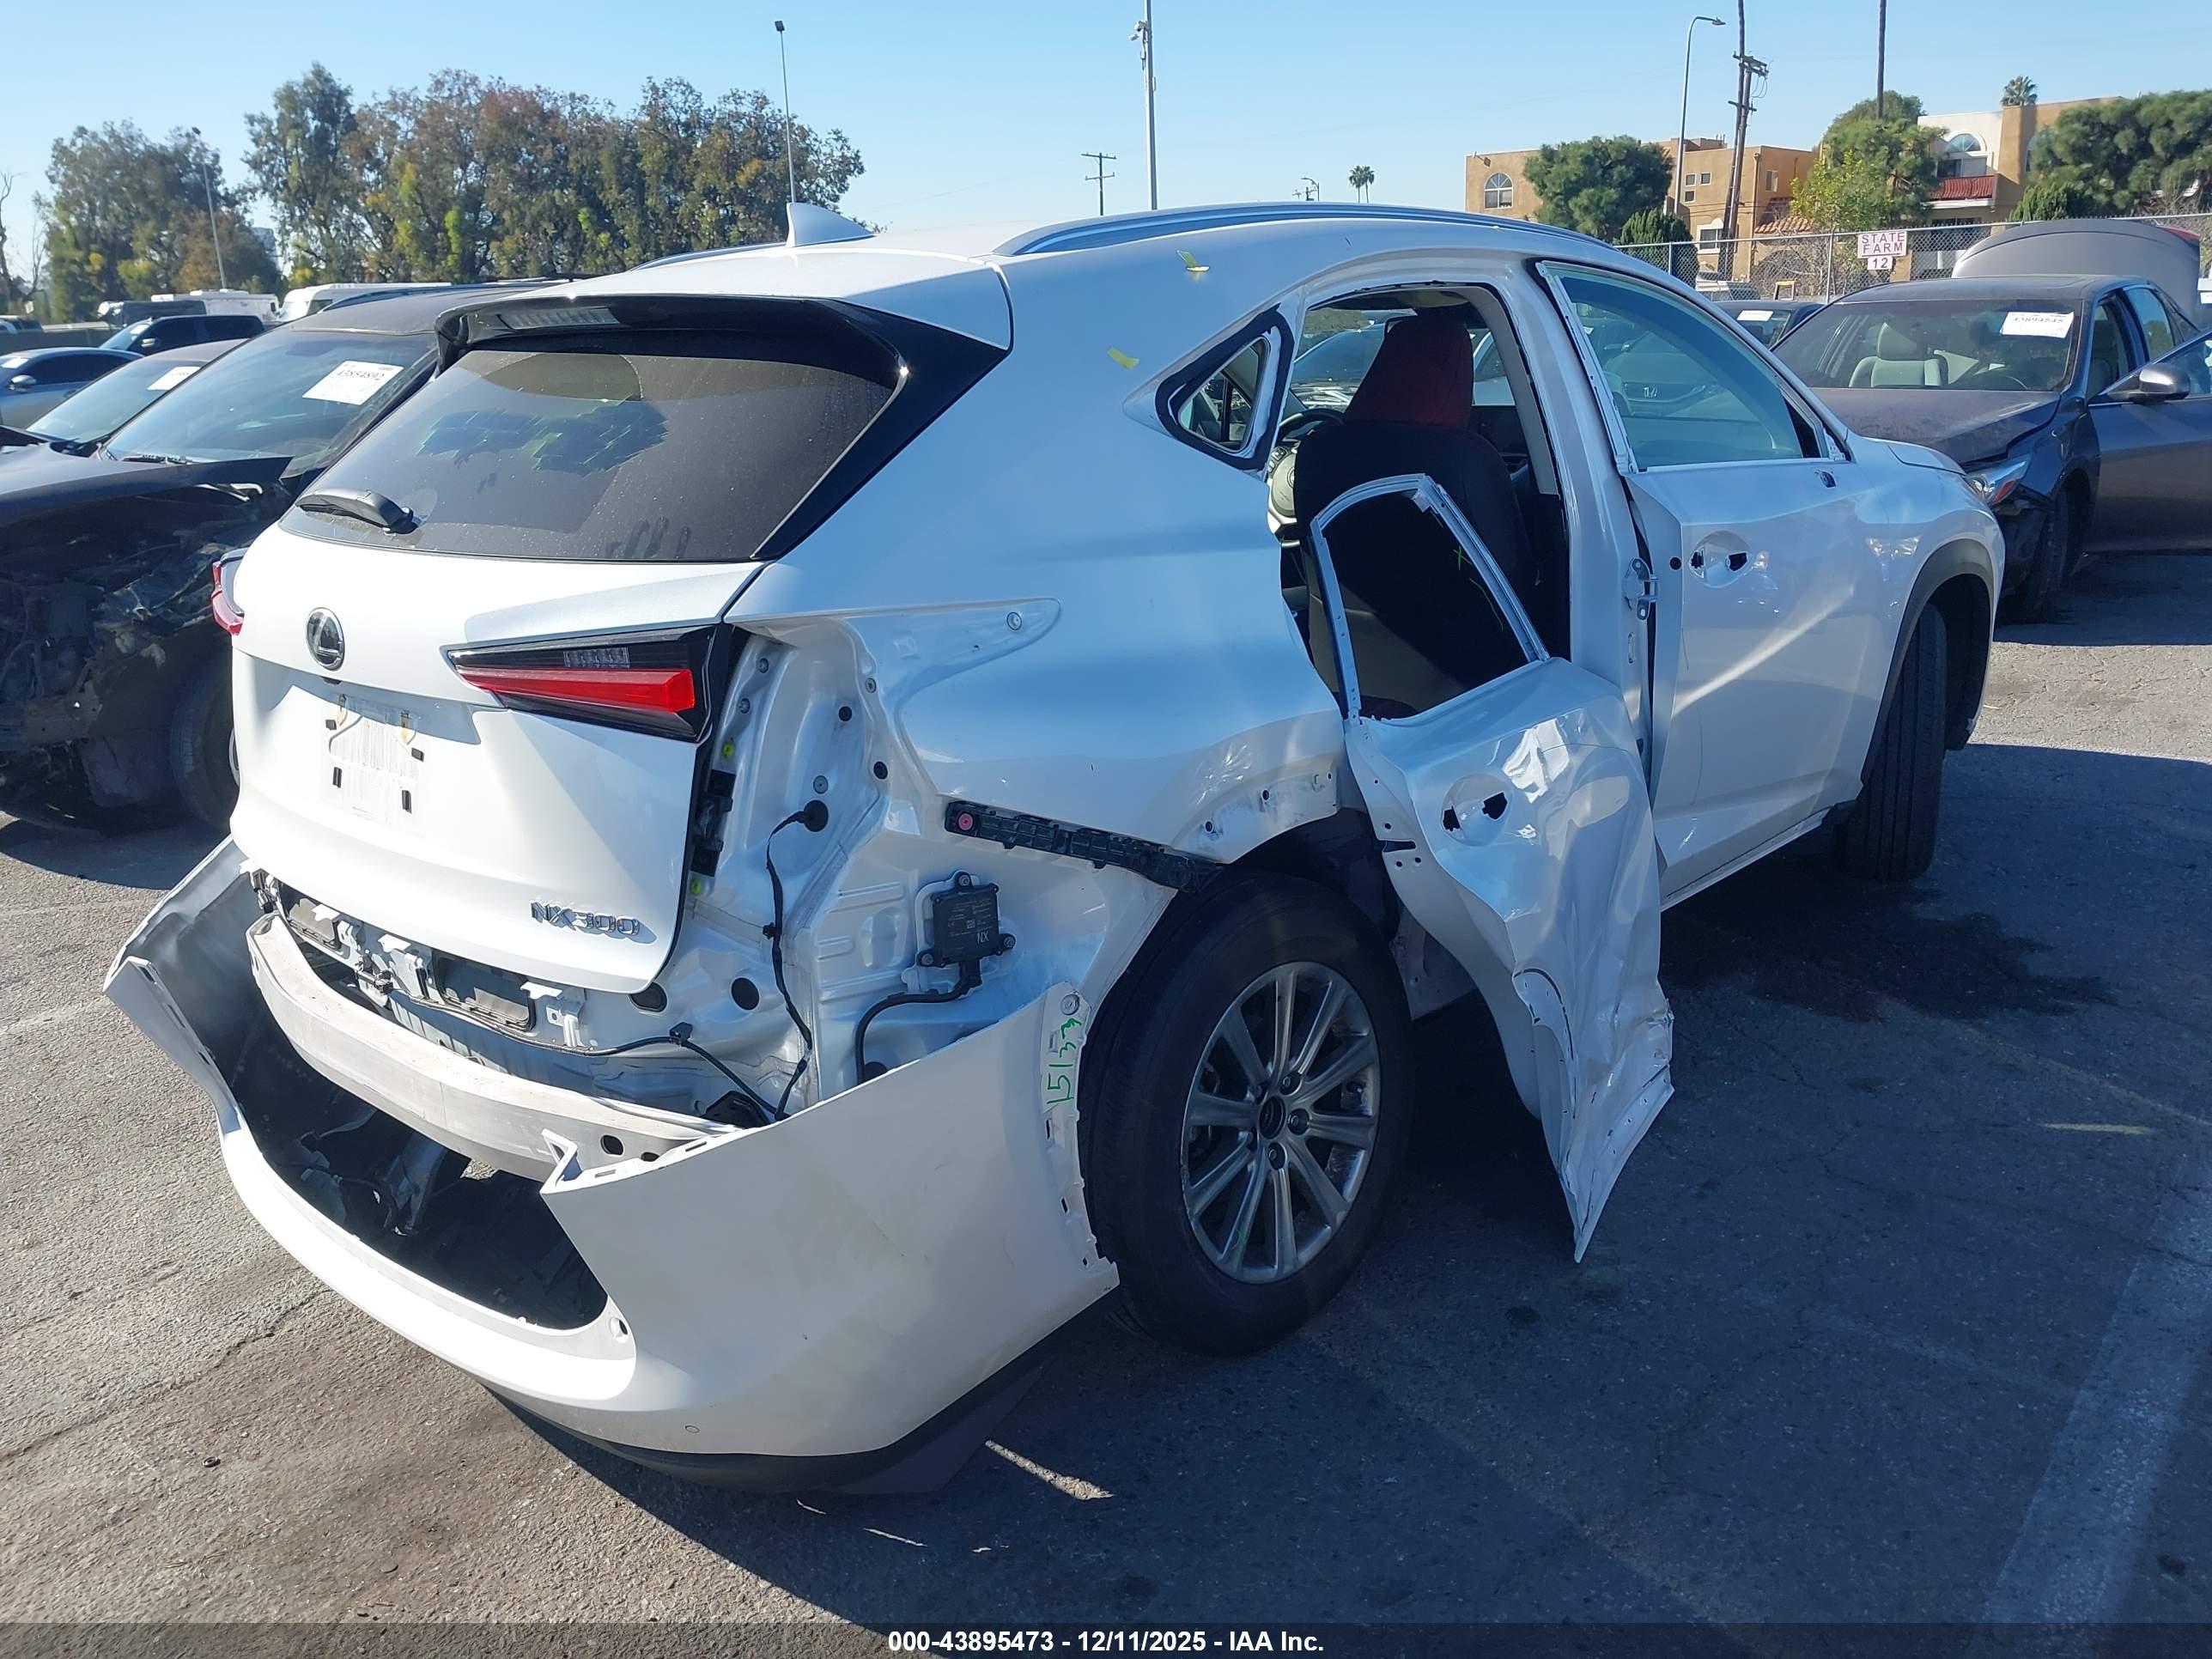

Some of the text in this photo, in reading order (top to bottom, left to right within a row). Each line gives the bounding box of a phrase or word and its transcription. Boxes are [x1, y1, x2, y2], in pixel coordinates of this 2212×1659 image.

[1862, 233, 1905, 244] STATE
[1863, 242, 1903, 253] FARM
[1872, 258, 1888, 269] 12
[976, 931, 989, 945] NX
